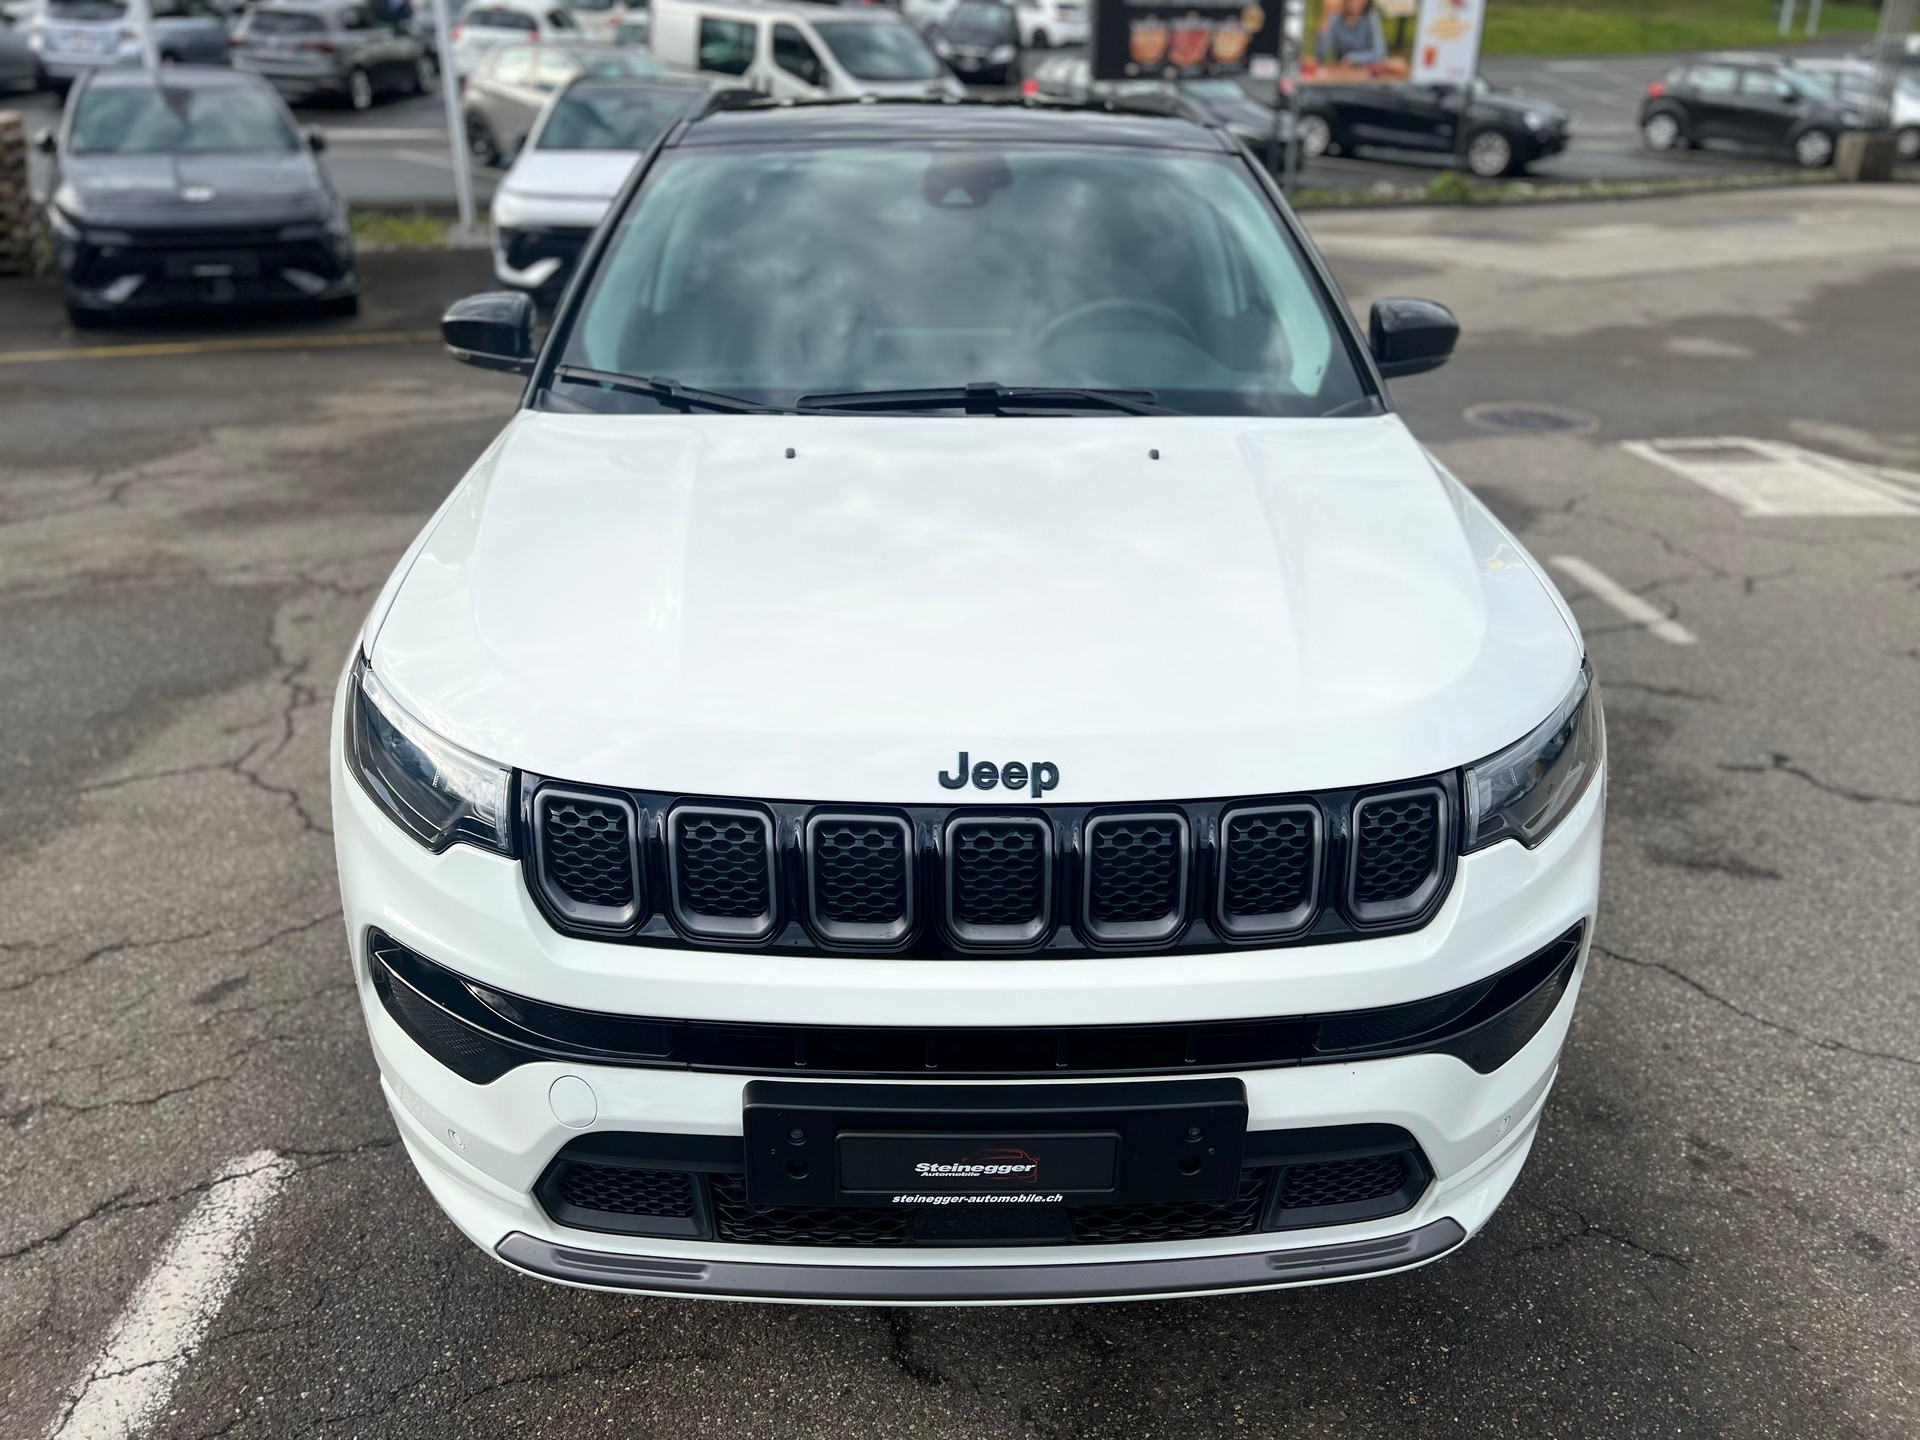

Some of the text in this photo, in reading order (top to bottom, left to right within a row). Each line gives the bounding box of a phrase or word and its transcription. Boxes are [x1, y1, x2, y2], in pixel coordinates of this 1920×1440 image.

[938, 751, 1060, 798] Jeep
[914, 1163, 1036, 1174] Steinegger
[892, 1193, 1063, 1205] steinegger-automobile.ch
